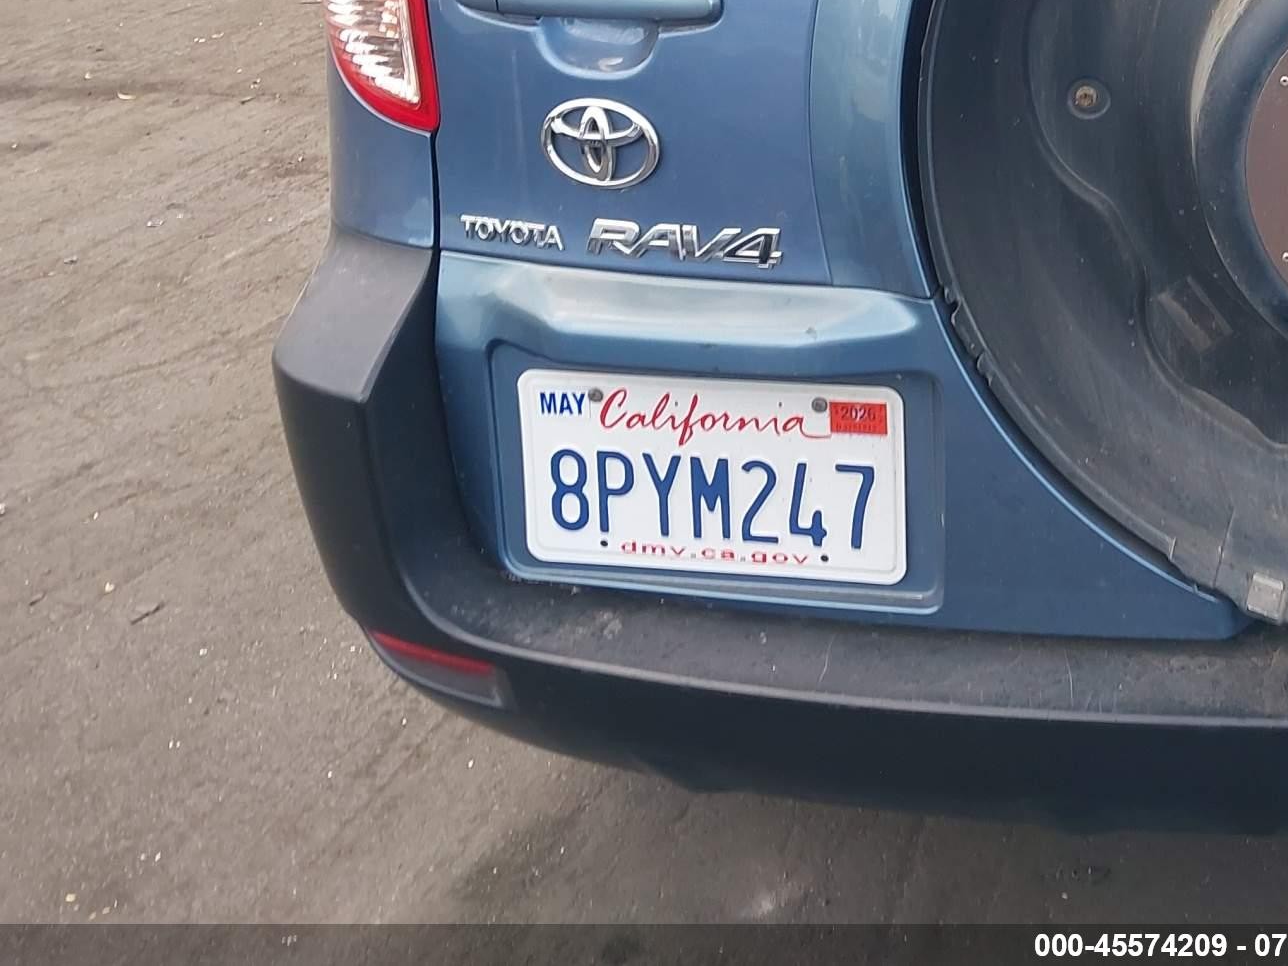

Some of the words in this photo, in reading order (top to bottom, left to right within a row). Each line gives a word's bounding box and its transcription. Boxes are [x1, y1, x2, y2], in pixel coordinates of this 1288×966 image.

[460, 214, 564, 251] TOYOTA
[586, 218, 783, 269] RAV4
[539, 391, 586, 416] MAY
[599, 387, 832, 446] California
[550, 448, 875, 550] 8PYM247
[620, 540, 809, 565] dmv.ca.gov
